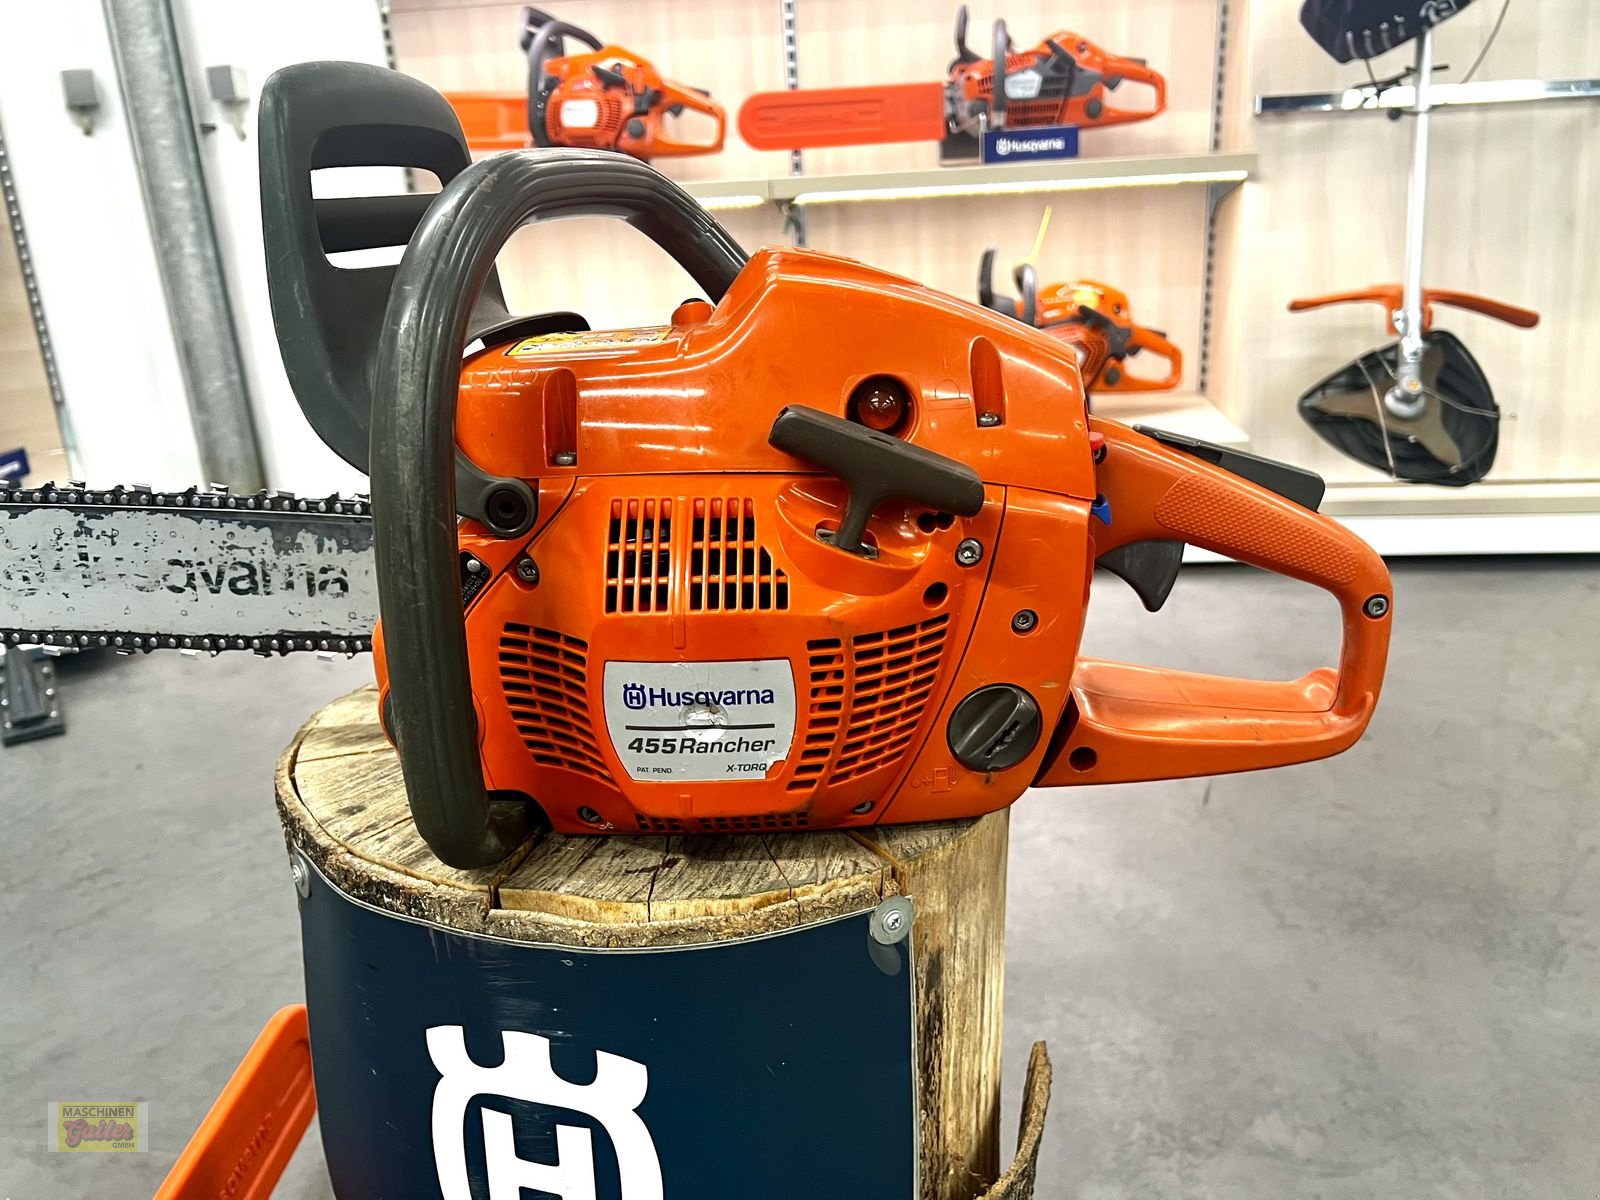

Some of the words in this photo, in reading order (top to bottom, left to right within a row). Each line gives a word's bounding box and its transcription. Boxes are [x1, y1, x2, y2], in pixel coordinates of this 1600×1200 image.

[1010, 137, 1066, 153] Husqvarna
[648, 688, 775, 707] Husqvarna
[628, 737, 677, 754] 455
[678, 736, 775, 754] Rancher
[725, 763, 768, 773] X-TORQ
